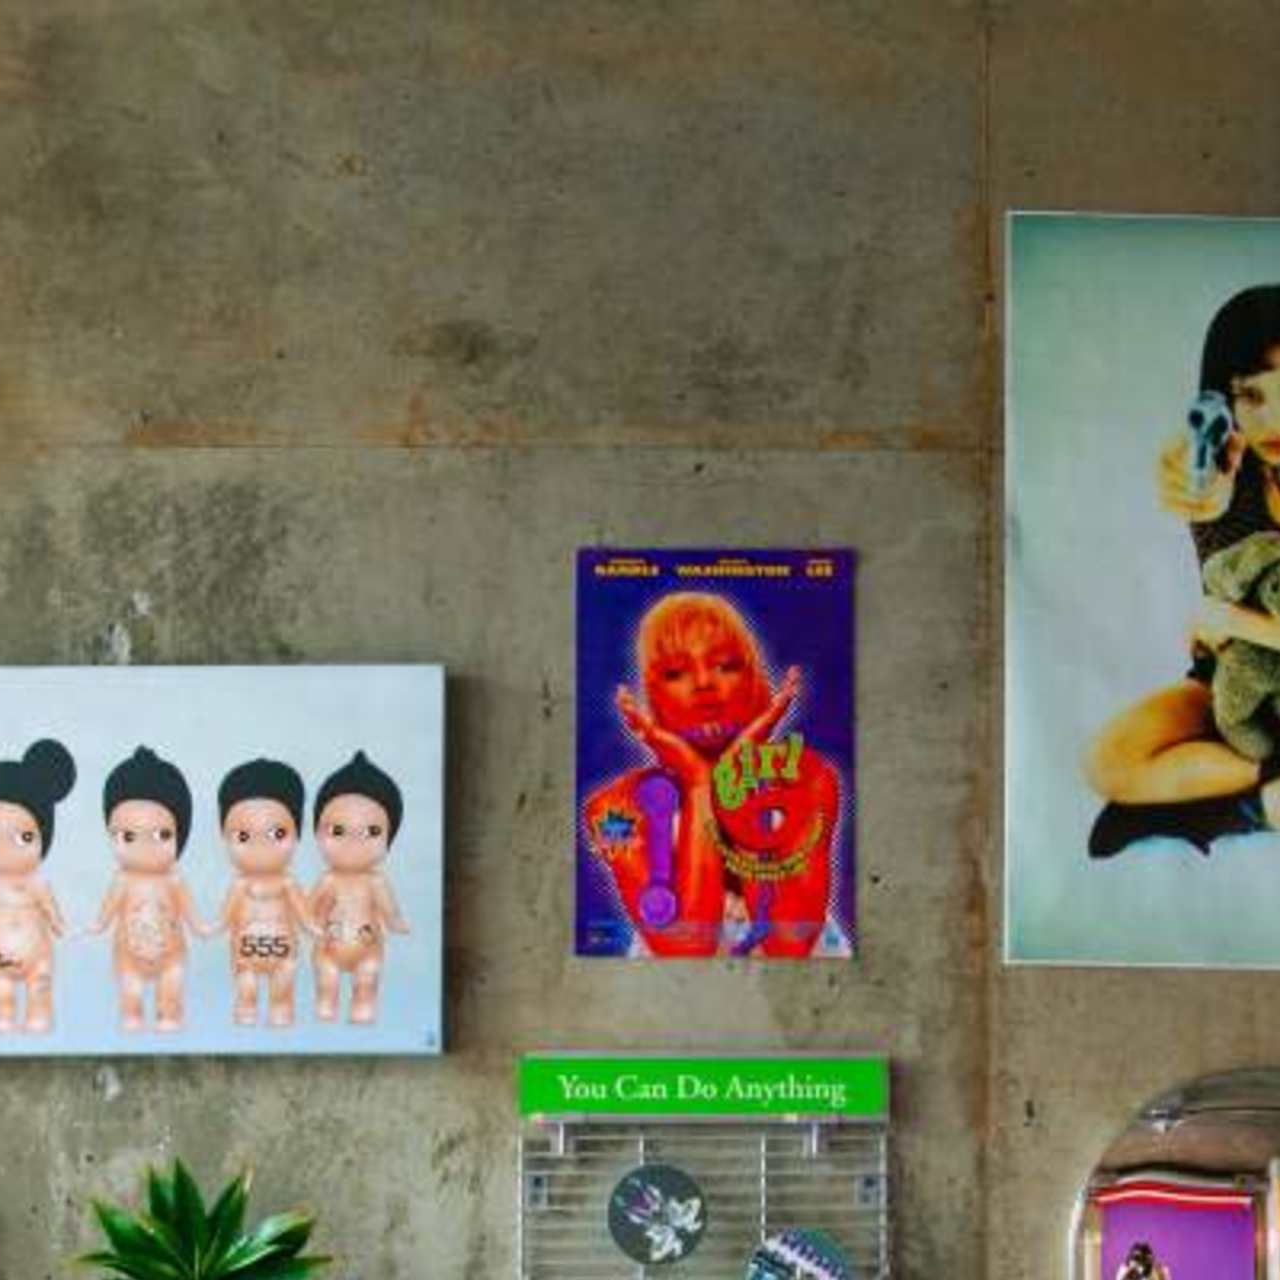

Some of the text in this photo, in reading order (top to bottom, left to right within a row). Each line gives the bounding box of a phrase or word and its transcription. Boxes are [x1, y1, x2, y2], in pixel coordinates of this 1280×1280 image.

[240, 935, 290, 957] 555
[558, 1073, 847, 1109] You Can Do Anything
